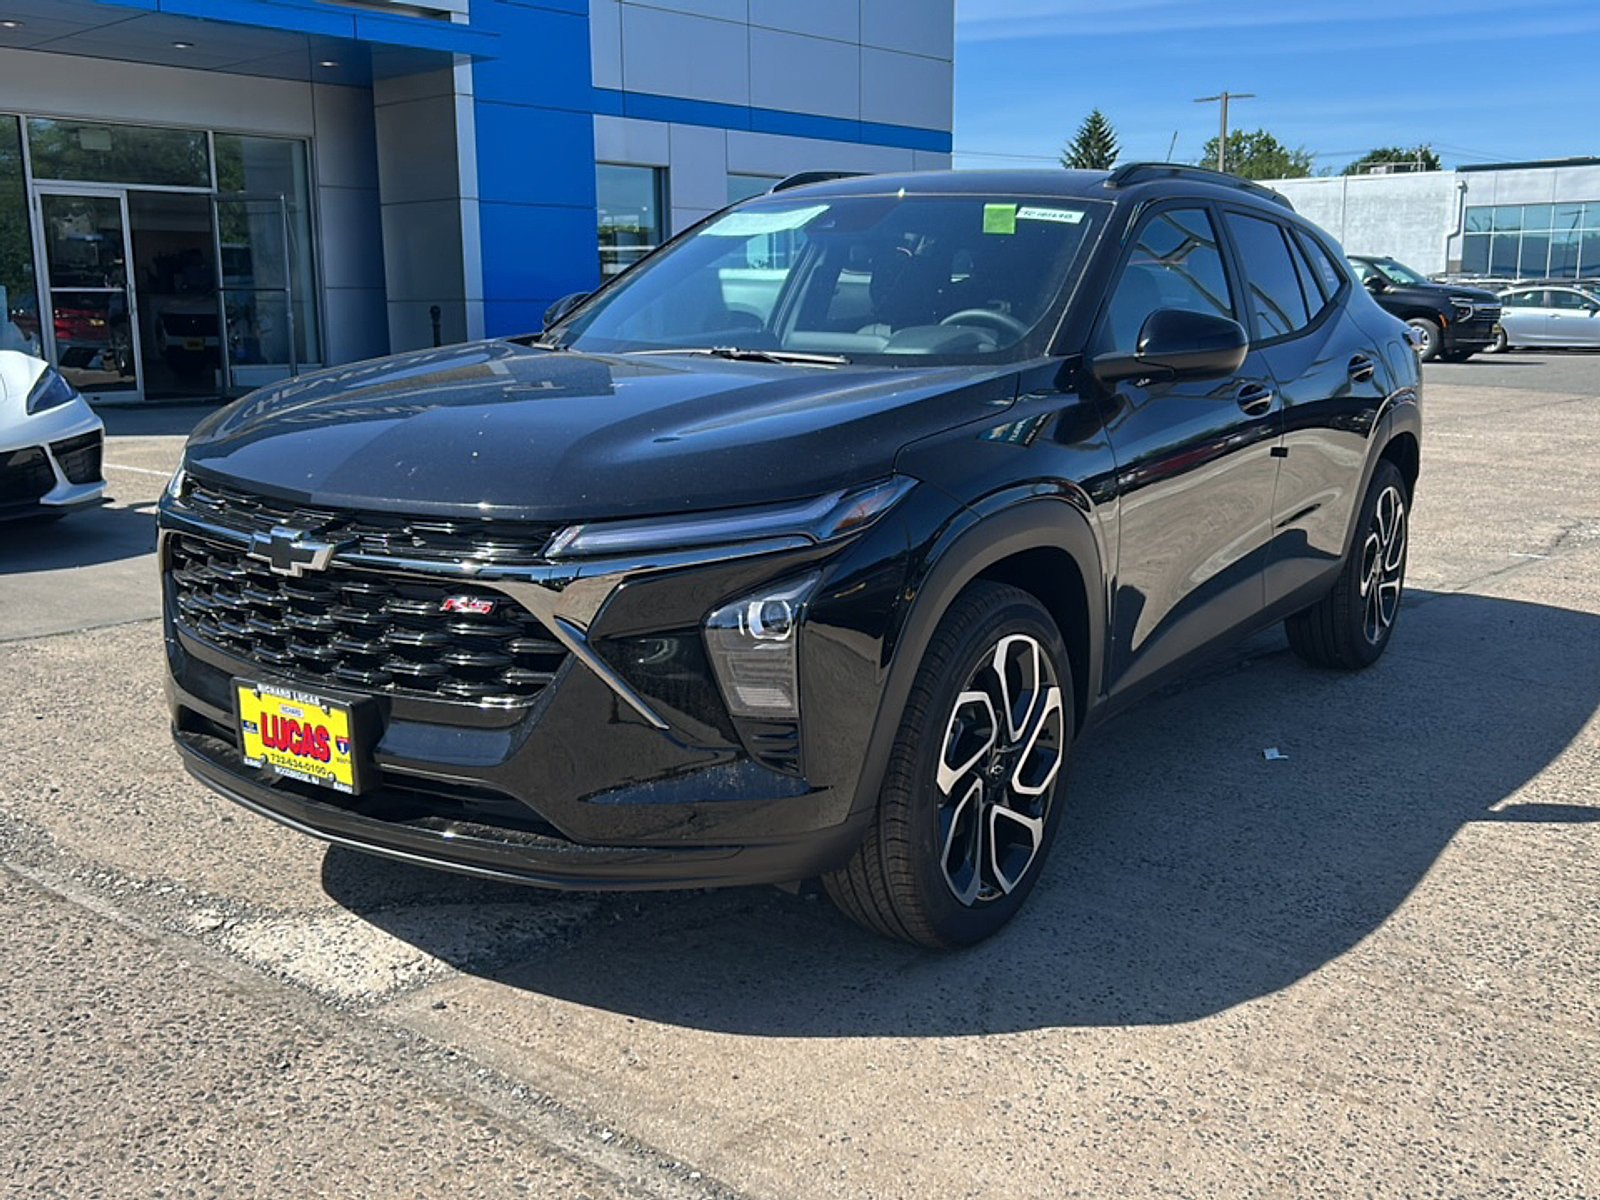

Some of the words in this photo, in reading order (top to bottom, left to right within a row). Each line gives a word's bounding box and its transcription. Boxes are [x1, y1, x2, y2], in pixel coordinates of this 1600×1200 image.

[440, 596, 493, 615] RS
[257, 683, 292, 699] RICHARD
[293, 690, 320, 706] LUCAS
[260, 711, 331, 763] LUCAS
